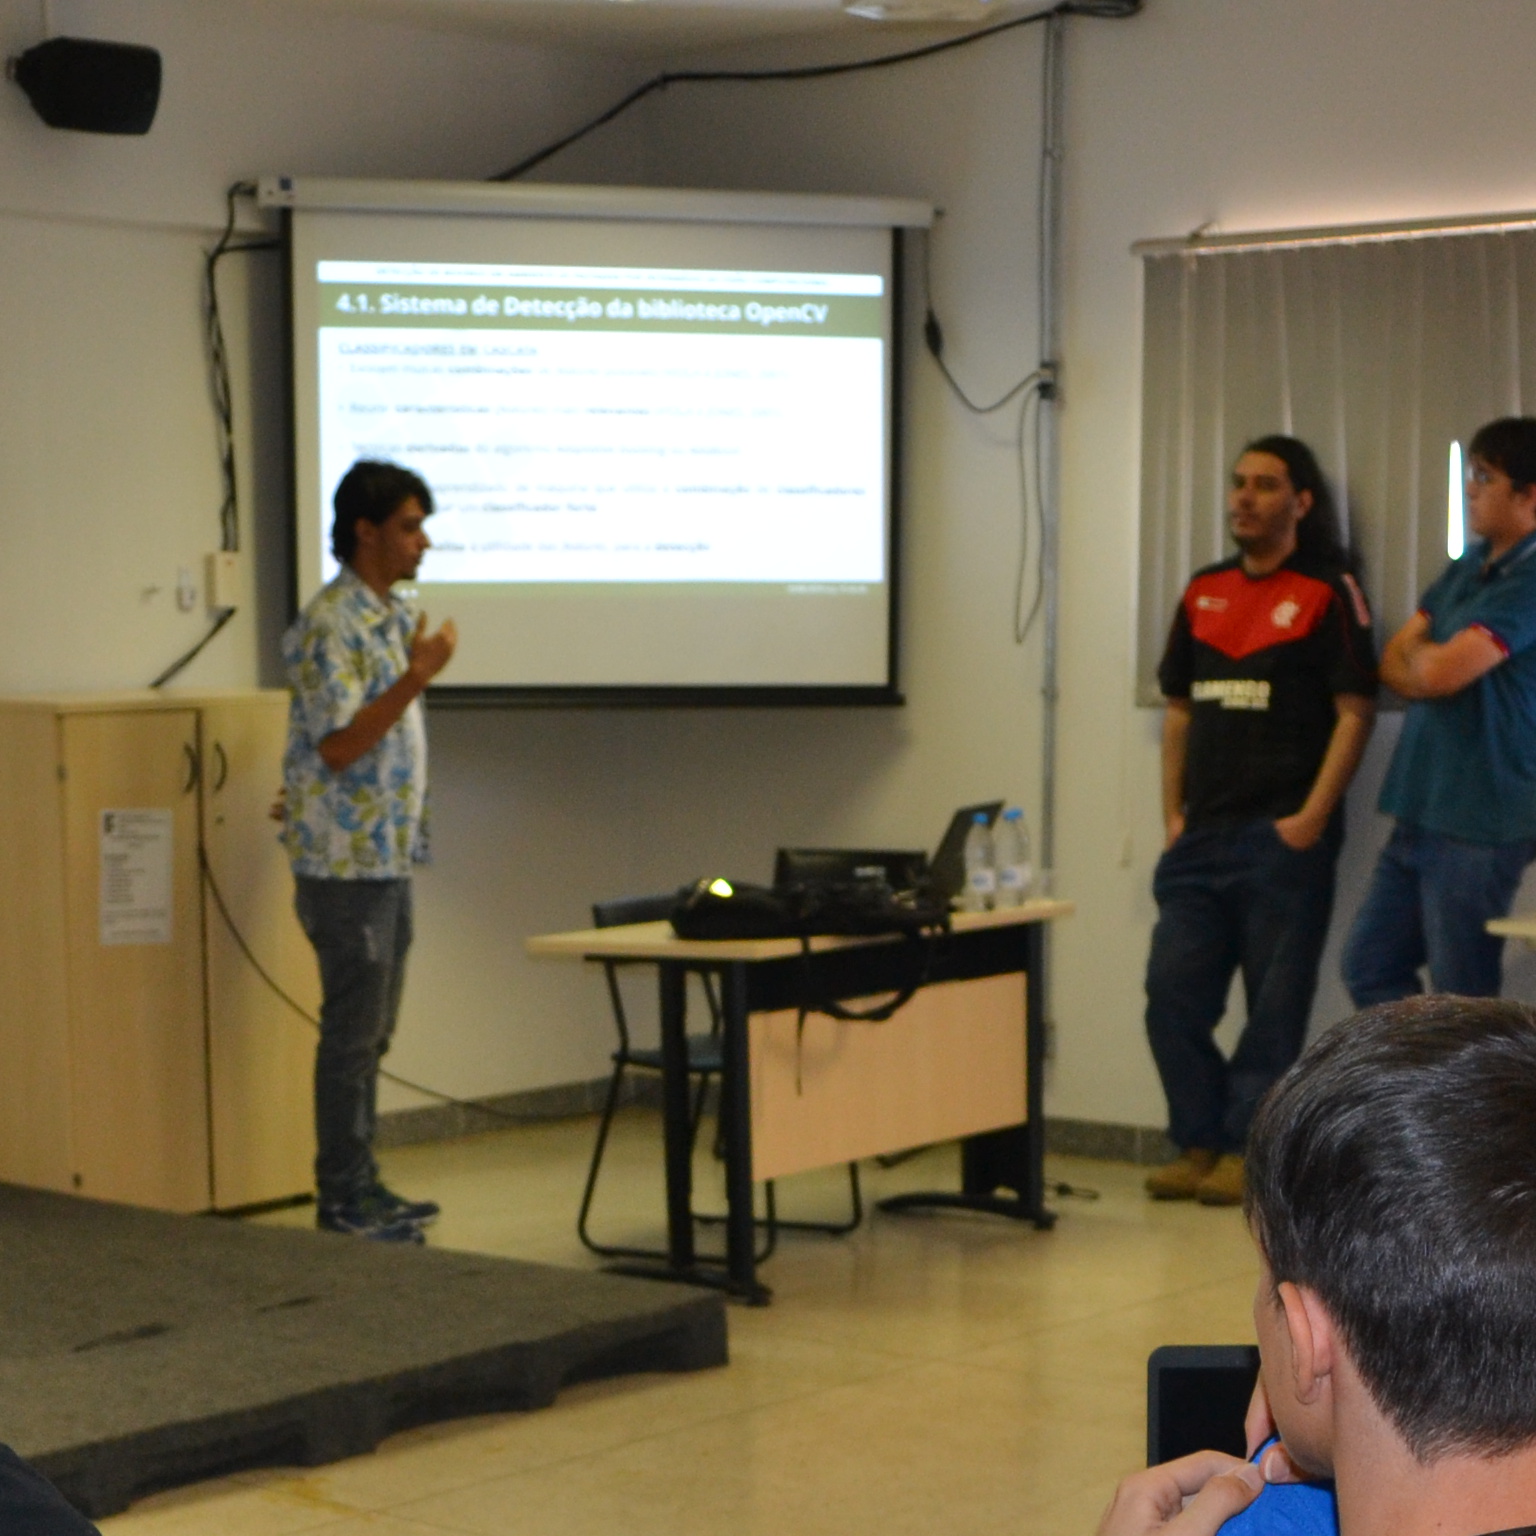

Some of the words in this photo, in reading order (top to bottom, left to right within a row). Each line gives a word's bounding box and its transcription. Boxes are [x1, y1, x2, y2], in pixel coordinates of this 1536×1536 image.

[336, 292, 375, 313] 4.1.
[379, 292, 467, 316] Sistema
[471, 295, 499, 316] de
[503, 296, 603, 322] Detecção
[606, 297, 633, 318] da
[637, 297, 741, 320] biblioteca
[745, 300, 829, 326] OpenCV
